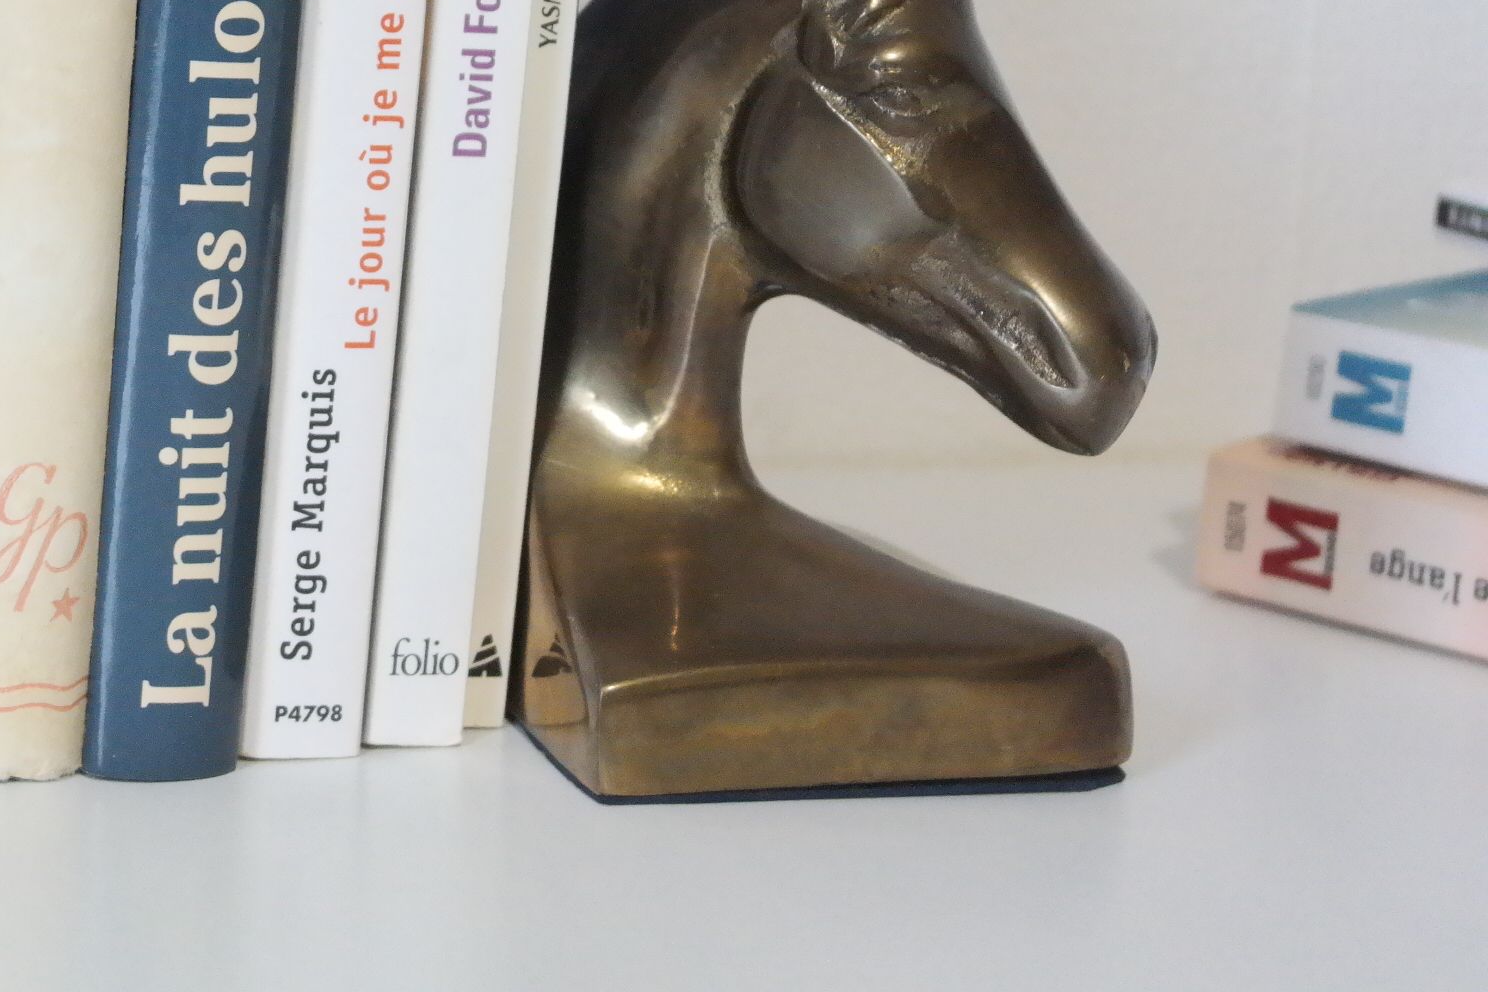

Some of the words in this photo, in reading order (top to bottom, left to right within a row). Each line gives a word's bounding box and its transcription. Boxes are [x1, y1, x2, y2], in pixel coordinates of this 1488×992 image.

[377, 12, 404, 70] me
[362, 89, 404, 128] je
[452, 48, 497, 158] David
[359, 144, 393, 191] où
[349, 207, 388, 291] jour
[168, 229, 247, 385] des
[344, 306, 379, 349] Le
[1331, 350, 1412, 434] M
[292, 369, 340, 533] Marquis
[158, 407, 233, 585] nuit
[1260, 496, 1339, 591] M
[1370, 548, 1461, 605] l'ange
[280, 550, 327, 661] Serge
[141, 605, 218, 708] La
[389, 637, 460, 677] folio
[274, 705, 343, 723] P4798
